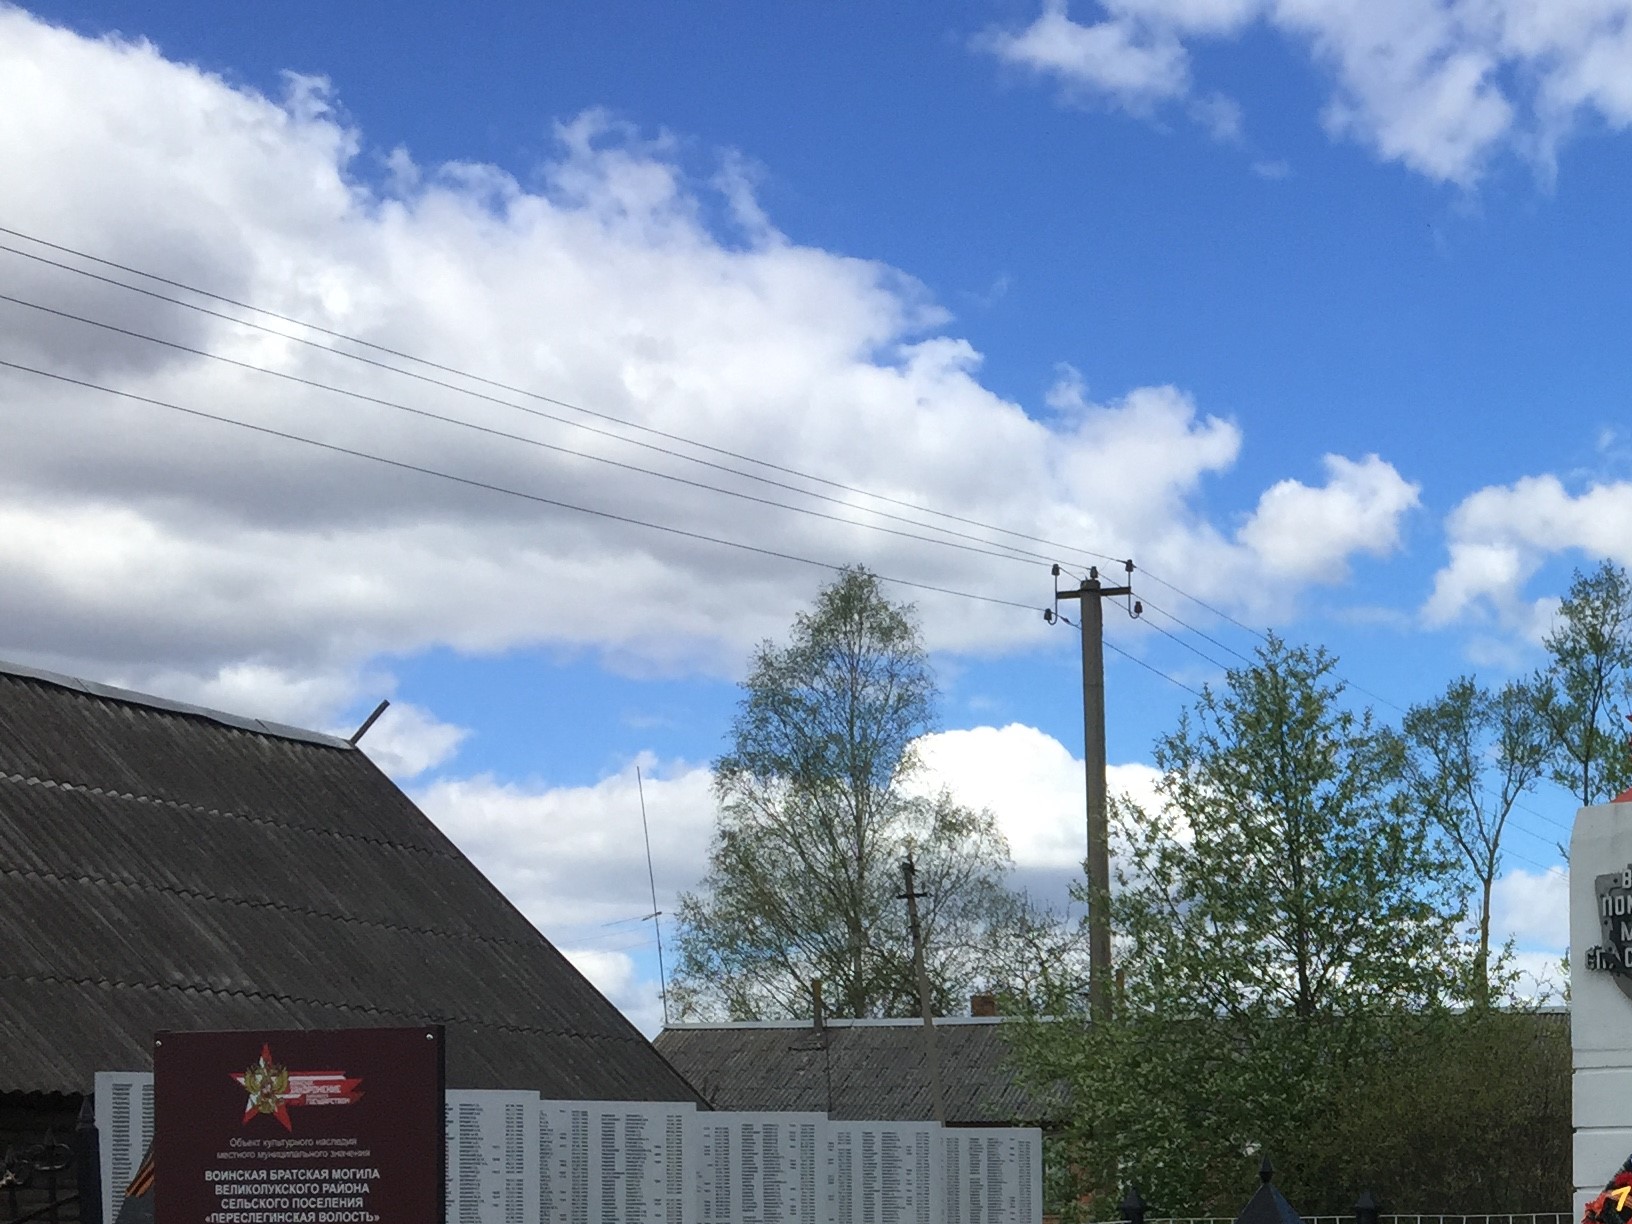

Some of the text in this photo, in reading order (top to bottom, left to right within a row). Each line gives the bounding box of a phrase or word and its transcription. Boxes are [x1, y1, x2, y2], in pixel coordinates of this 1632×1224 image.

[205, 1168, 380, 1181] ВОИНСКАЯ БРАТСКАЯ МОГИЛА
[215, 1181, 369, 1195] ВЕЛИКОЛУКСКОГО РАЙОНА
[221, 1197, 364, 1210] СЕЛЬСКОГО ПОСЕЛЕНИЯ
[205, 1211, 380, 1223] «ПЕРЕСЛЕГИНСКАЯ ВОЛОСТЬ»
